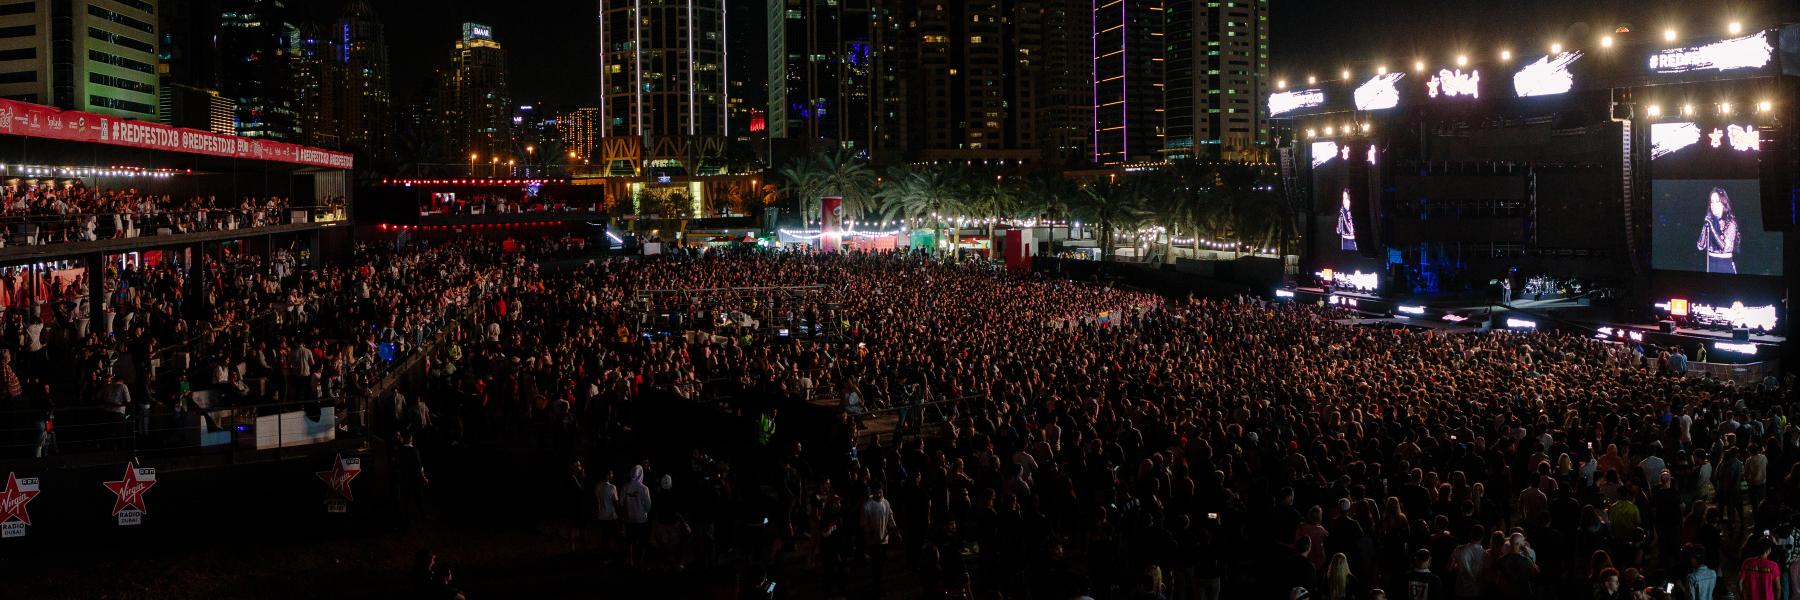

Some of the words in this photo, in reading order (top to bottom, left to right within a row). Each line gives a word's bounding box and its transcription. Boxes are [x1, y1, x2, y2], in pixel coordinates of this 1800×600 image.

[112, 121, 179, 148] #REDFESTDXB
[182, 131, 236, 154] @REDFESTDXB
[1, 488, 30, 514] Virgin
[119, 478, 146, 503] Virgin
